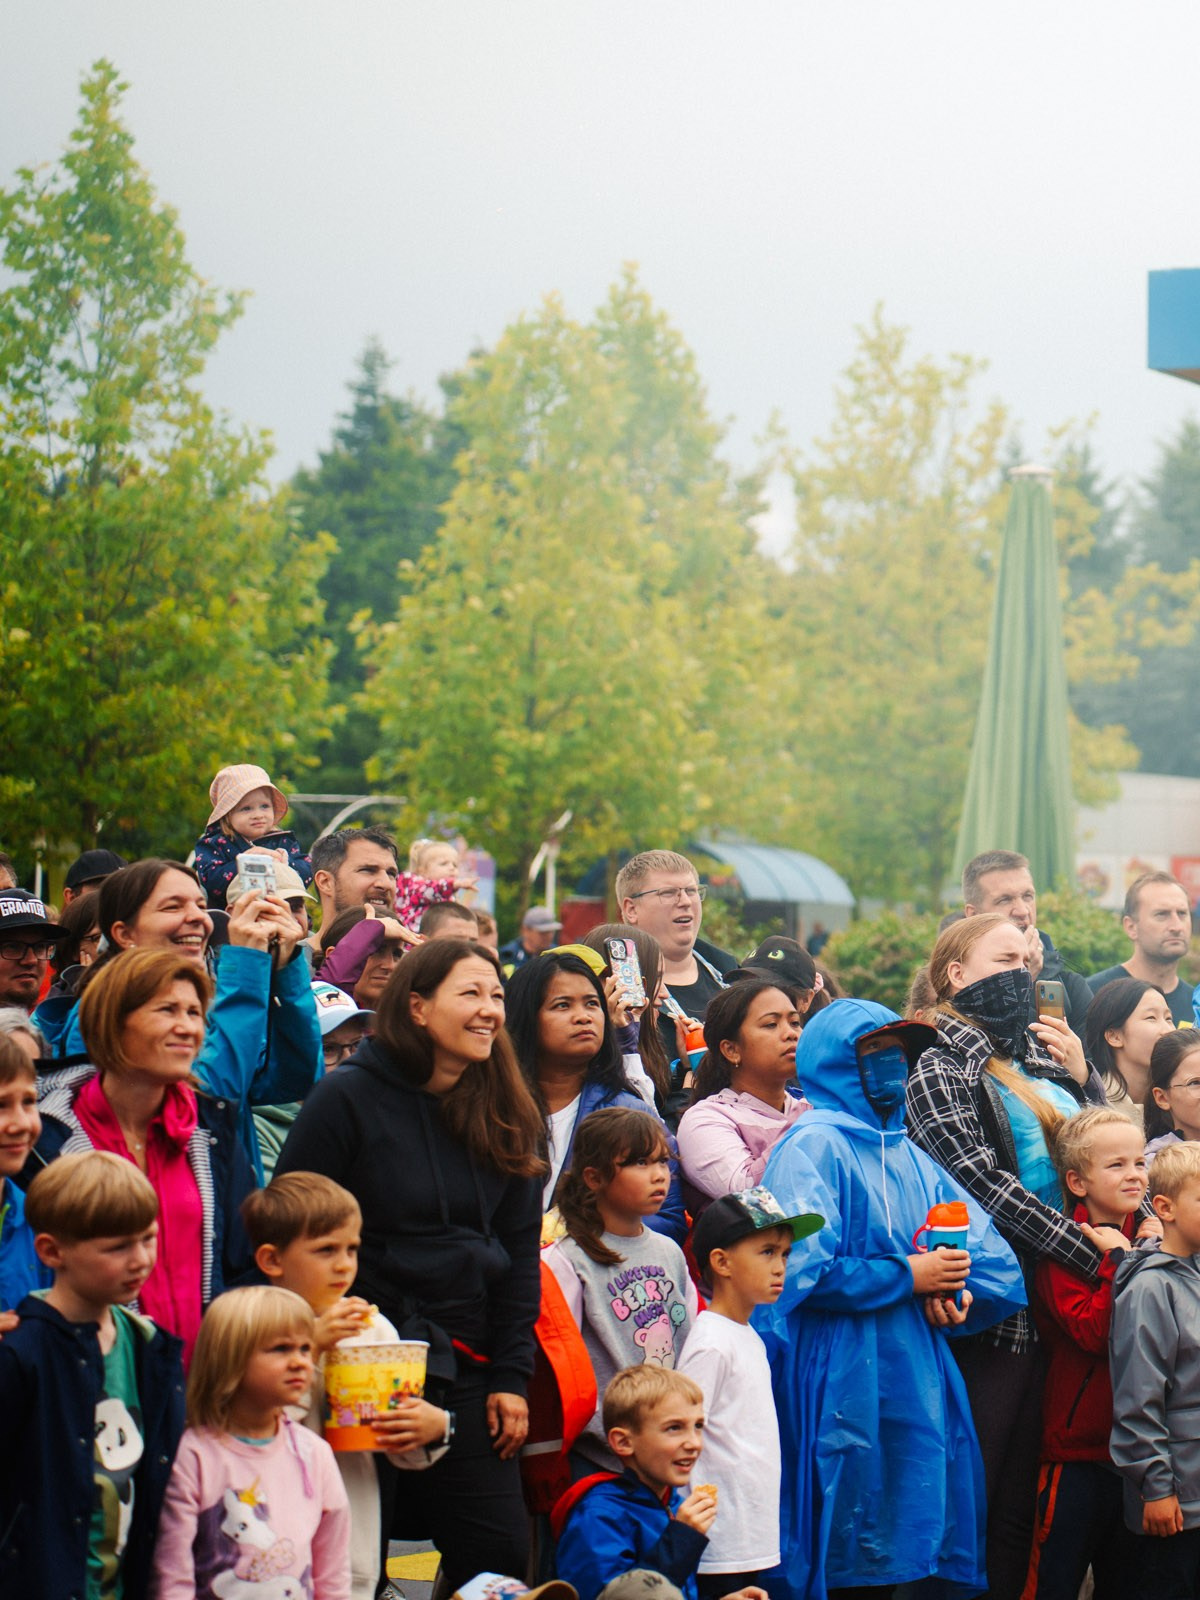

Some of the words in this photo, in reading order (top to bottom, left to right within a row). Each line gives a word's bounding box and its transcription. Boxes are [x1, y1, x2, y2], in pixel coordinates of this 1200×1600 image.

[608, 1282, 617, 1296] I
[614, 1266, 643, 1291] LIKE
[641, 1264, 666, 1278] YOU
[610, 1279, 674, 1322] BEARY
